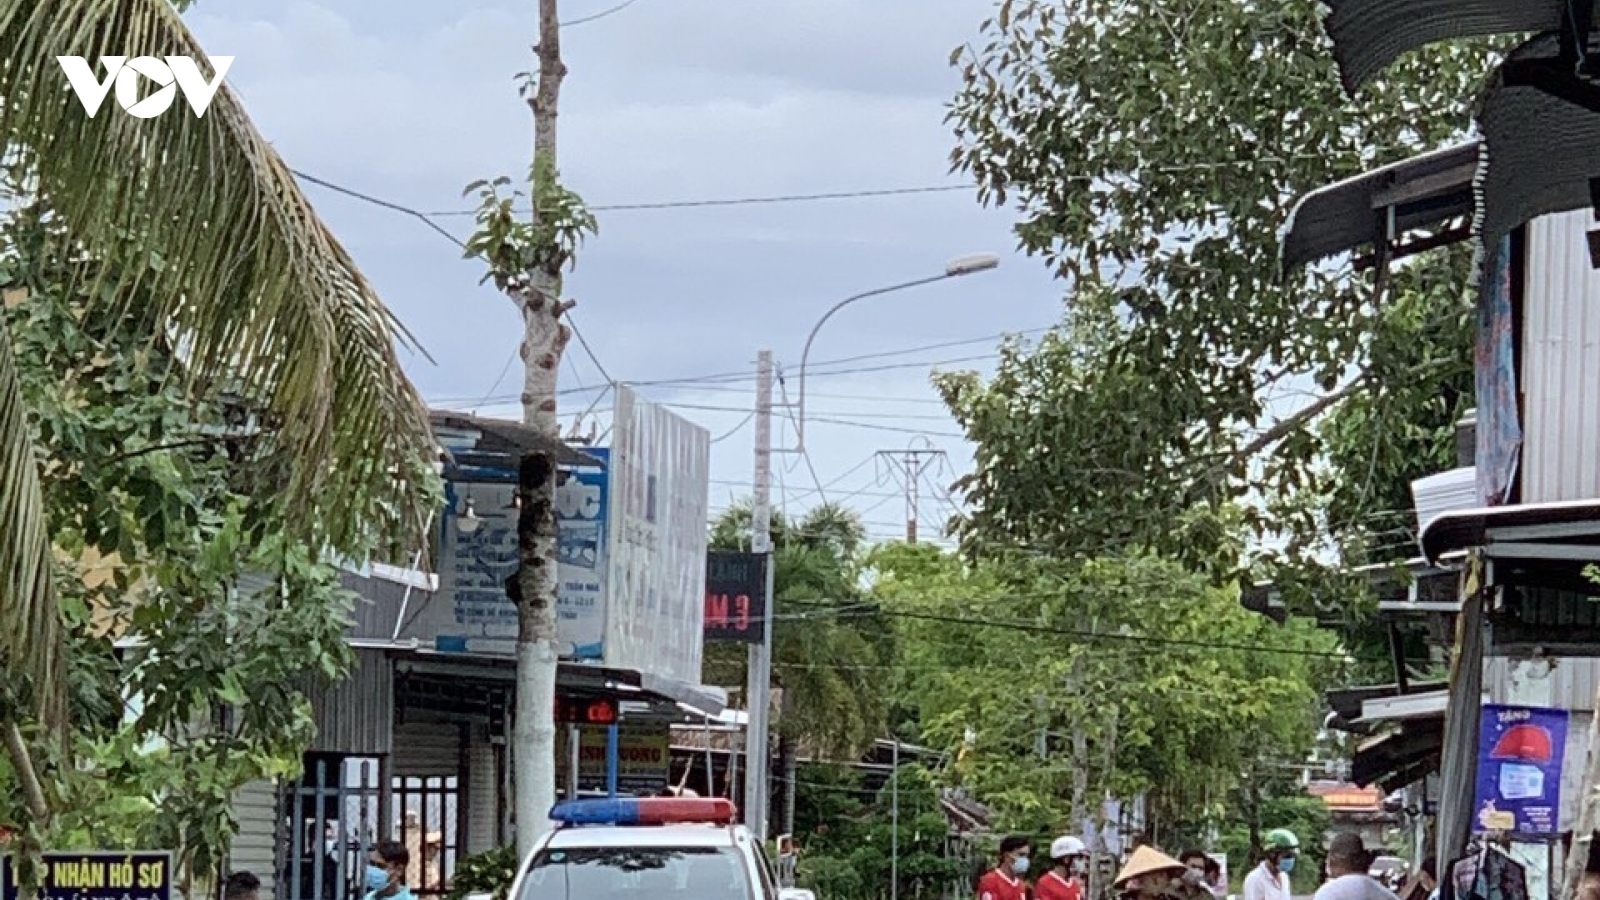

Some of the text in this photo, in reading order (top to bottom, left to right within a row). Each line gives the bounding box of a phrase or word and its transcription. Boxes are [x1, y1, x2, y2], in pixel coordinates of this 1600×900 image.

[735, 594, 749, 630] 3
[54, 857, 104, 893] NHẬN
[109, 855, 133, 888] HỒ
[138, 860, 163, 888] SƠ
